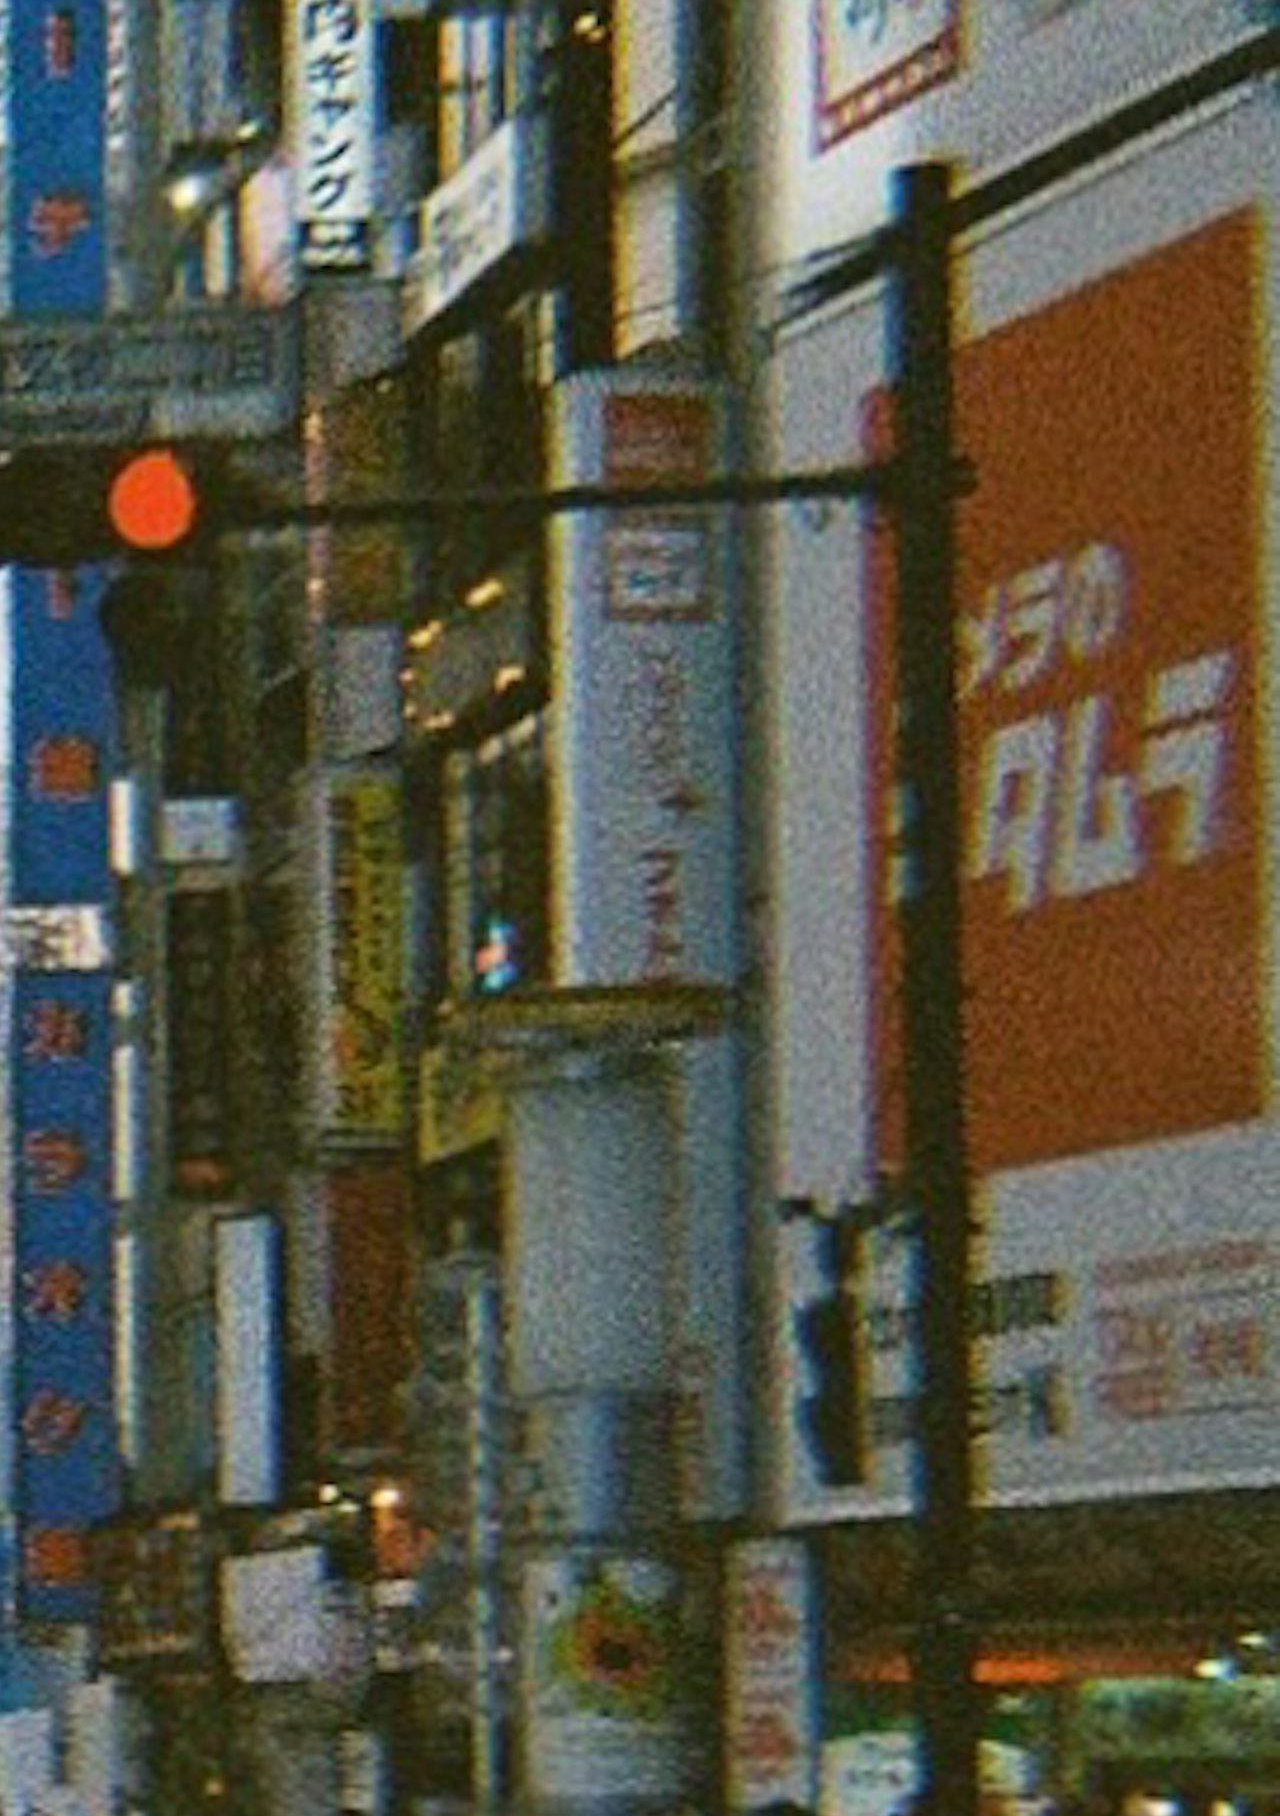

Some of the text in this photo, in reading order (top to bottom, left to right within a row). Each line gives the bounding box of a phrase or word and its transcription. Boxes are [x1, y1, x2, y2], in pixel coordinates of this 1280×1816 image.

[902, 541, 1127, 725] メラの
[888, 651, 1237, 919] タムラ
